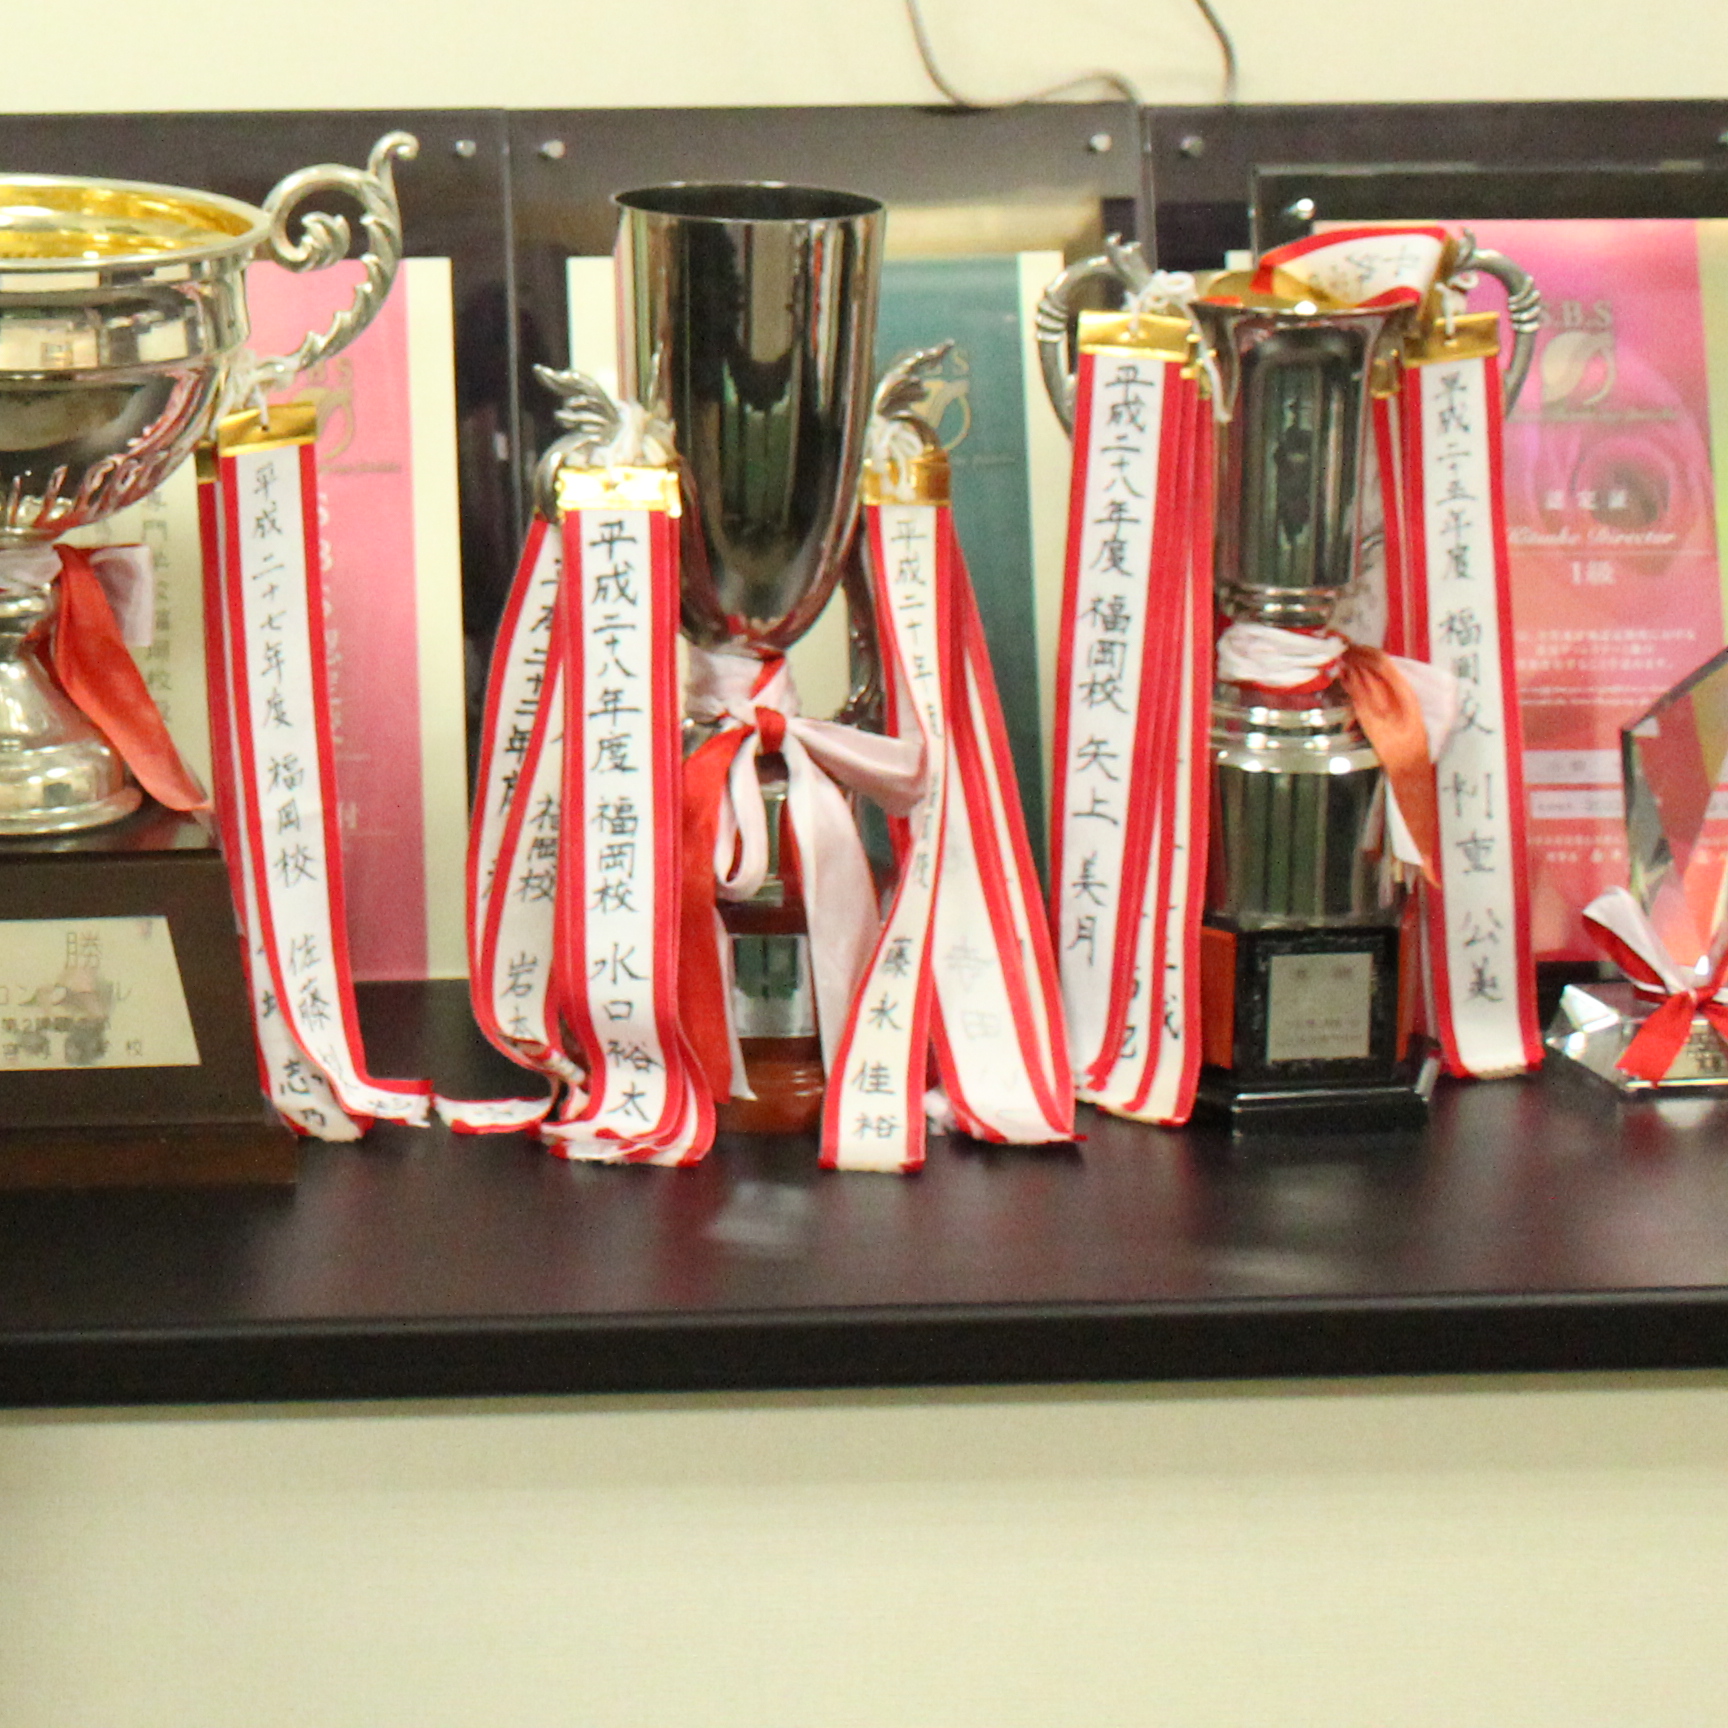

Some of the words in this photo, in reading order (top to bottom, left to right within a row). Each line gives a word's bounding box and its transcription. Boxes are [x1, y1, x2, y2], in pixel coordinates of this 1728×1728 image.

[1091, 364, 1155, 578] 平成二十八年度
[588, 519, 644, 774] 平成二十八年度
[1079, 594, 1130, 715] 福岡校
[592, 795, 639, 914] 福岡校
